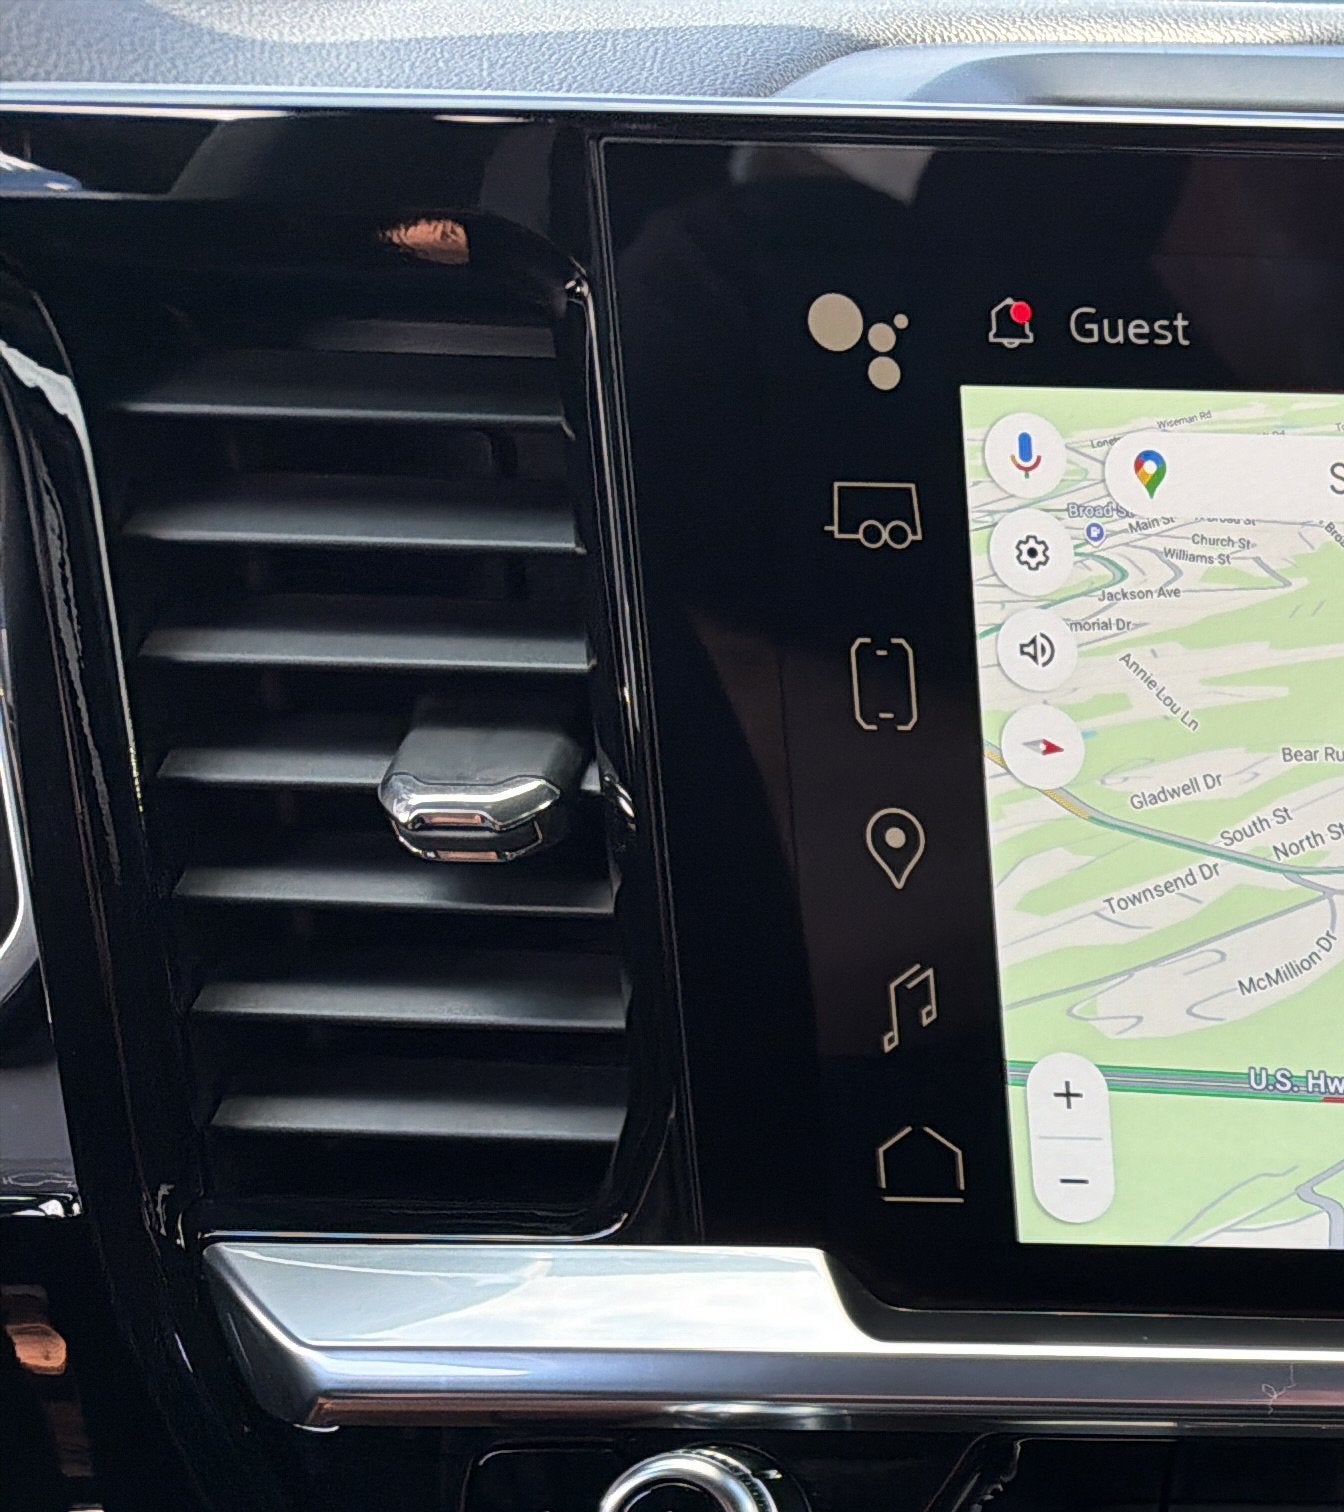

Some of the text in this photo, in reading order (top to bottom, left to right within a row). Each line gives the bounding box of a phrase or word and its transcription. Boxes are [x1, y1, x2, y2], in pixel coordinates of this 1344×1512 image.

[1069, 307, 1190, 345] Guest
[1199, 410, 1212, 420] Rd
[1068, 501, 1114, 518] Broad
[1128, 519, 1160, 534] Main
[1191, 533, 1251, 549] Church St
[1164, 547, 1231, 565] Williams St
[1098, 586, 1181, 602] Jackson Ave
[1069, 618, 1132, 632] morial Dr
[1119, 652, 1200, 732] Annie Lou Ln
[1281, 746, 1319, 763] Bear
[1129, 771, 1223, 811] Gladwell Dr
[1219, 806, 1294, 848] South St
[1273, 828, 1324, 861] North
[1103, 860, 1221, 915] Townsend Dr
[1237, 930, 1338, 996] McMillion Dr
[1248, 1067, 1299, 1092] U.S.
